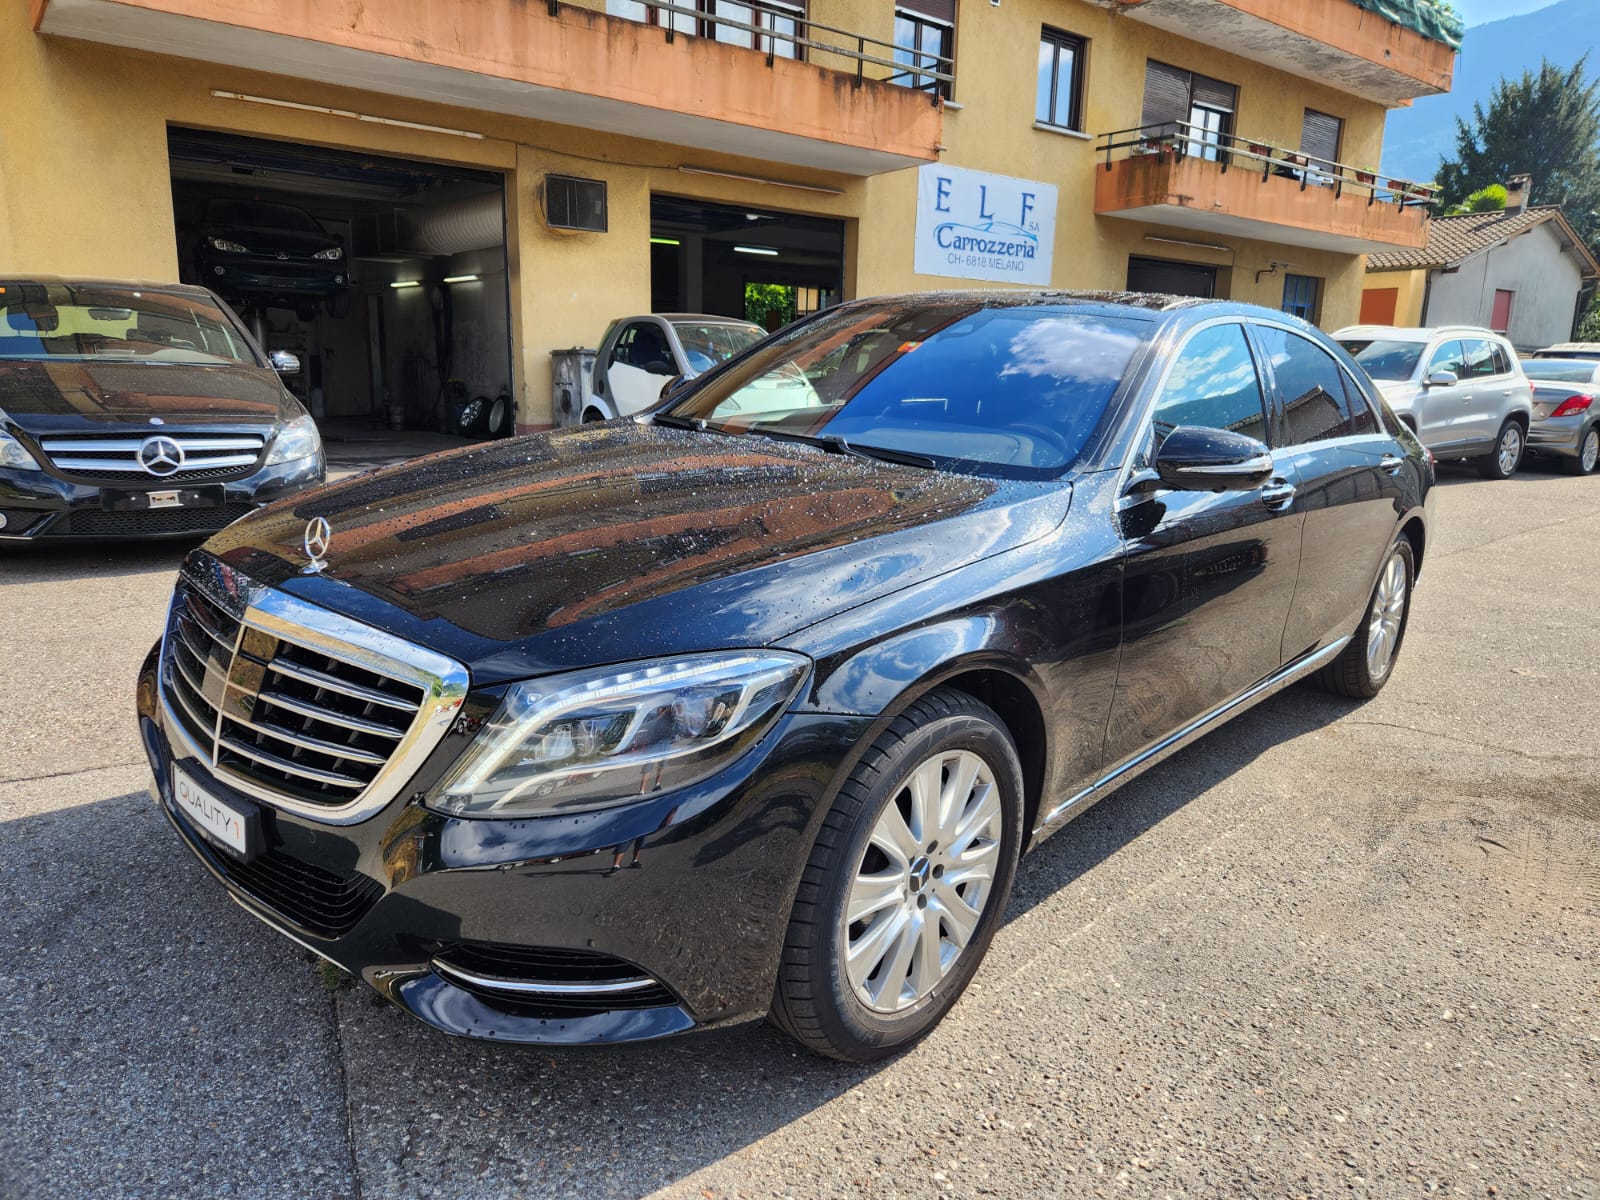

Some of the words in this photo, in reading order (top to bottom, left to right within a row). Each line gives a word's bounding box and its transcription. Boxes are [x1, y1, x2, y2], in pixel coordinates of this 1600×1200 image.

[1028, 222, 1040, 232] SA
[937, 225, 1035, 258] Carrozzeria
[966, 255, 987, 268] 6818
[988, 258, 1025, 272] MELANO
